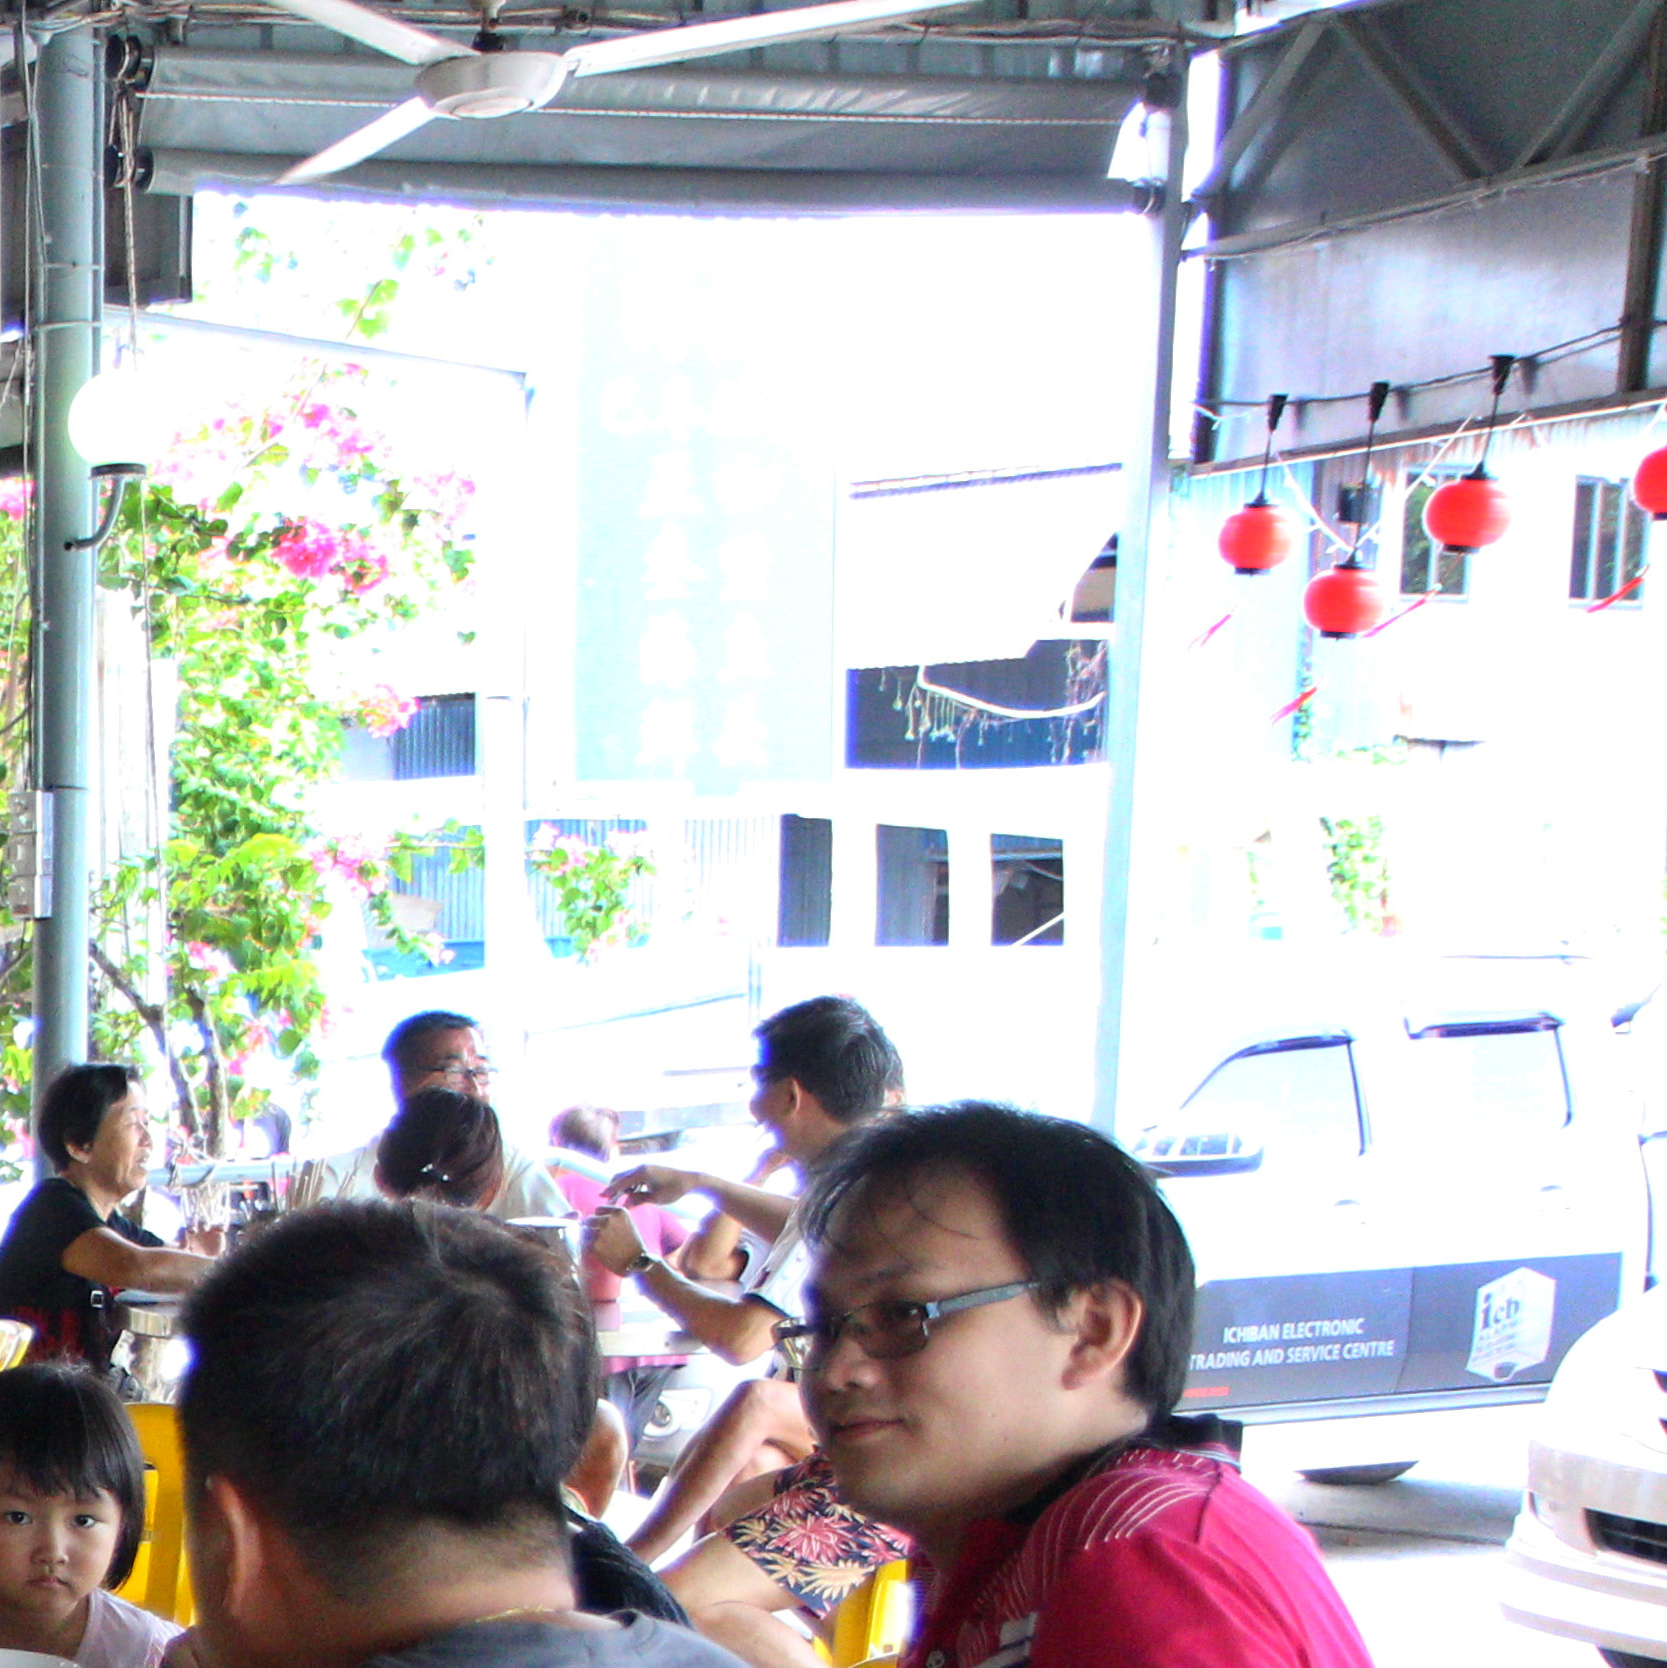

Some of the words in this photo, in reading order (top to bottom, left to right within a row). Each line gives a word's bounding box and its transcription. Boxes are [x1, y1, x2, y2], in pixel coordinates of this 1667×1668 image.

[1222, 1322, 1280, 1344] ICHIBAN
[1282, 1317, 1366, 1339] ELECTRONIC
[1189, 1350, 1252, 1371] TRADING
[1252, 1348, 1285, 1366] AND
[1285, 1343, 1341, 1364] SERVICE
[1342, 1340, 1395, 1360] CENTRE
